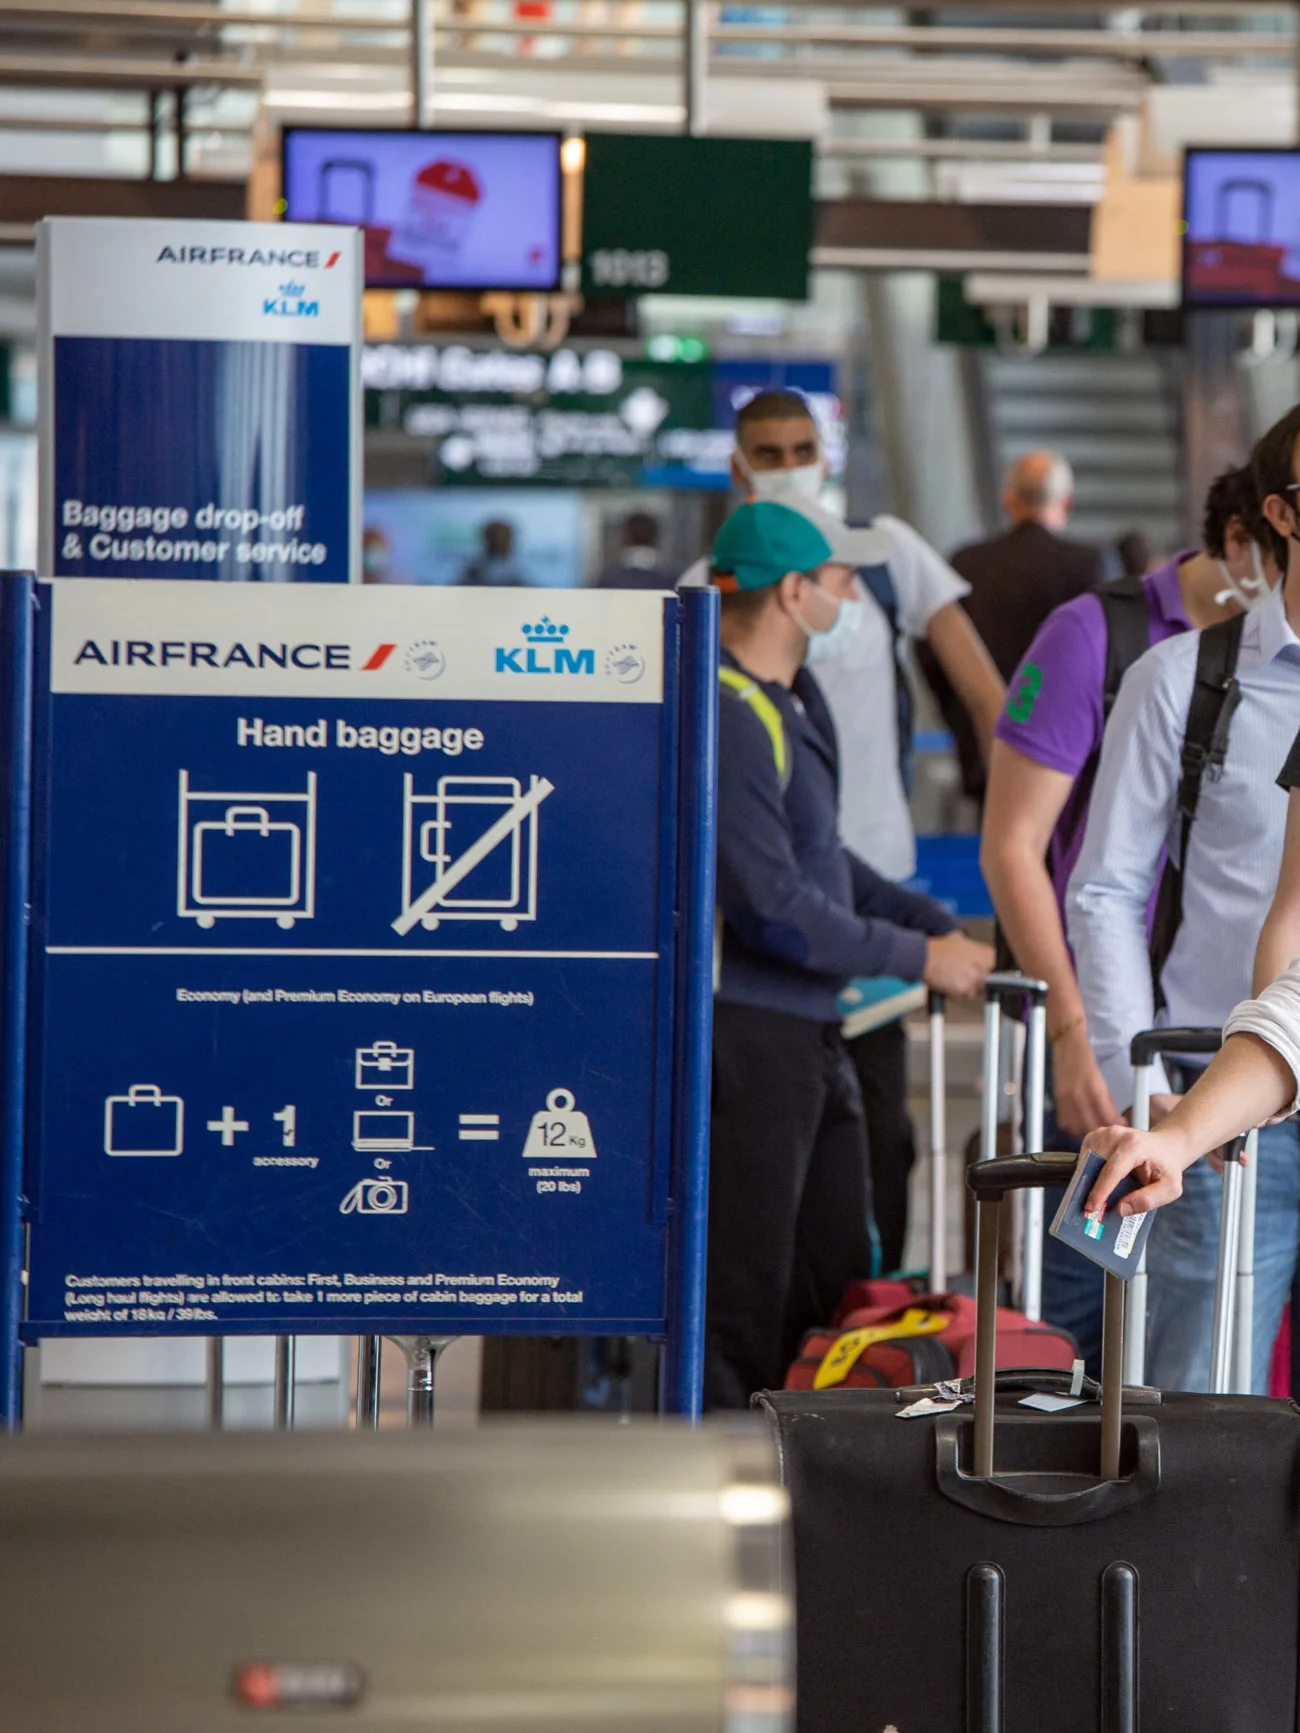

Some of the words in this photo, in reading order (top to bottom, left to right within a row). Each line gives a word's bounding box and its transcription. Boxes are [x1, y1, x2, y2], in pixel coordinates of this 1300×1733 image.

[156, 245, 320, 268] AIRFRANCE
[263, 299, 319, 317] KLM
[62, 500, 189, 533] Baggage
[194, 503, 305, 534] drop-off
[62, 533, 83, 560] &
[90, 534, 231, 562] Customer
[235, 539, 327, 565] service
[73, 639, 352, 671] AIRFRANCE
[495, 647, 595, 675] KLM
[238, 717, 328, 748] Hand
[336, 719, 485, 756] baggage
[176, 988, 241, 1005] Economy
[243, 988, 274, 1005] (and
[274, 989, 336, 1003] Premium
[337, 989, 401, 1006] Economy
[402, 992, 422, 1004] on
[423, 990, 487, 1006] European
[488, 991, 534, 1007] flights)
[375, 1094, 394, 1107] Or
[537, 1121, 567, 1147] 12
[568, 1135, 587, 1149] Kg
[252, 1156, 319, 1169] accessory
[373, 1157, 393, 1170] Or
[528, 1165, 591, 1178] maximum
[536, 1180, 557, 1195] (20
[558, 1180, 582, 1195] lbs)
[65, 1274, 142, 1288] Customers
[142, 1274, 206, 1289] travelling
[206, 1274, 221, 1286] in
[221, 1274, 256, 1286] front
[256, 1274, 306, 1286] cabins:
[307, 1273, 343, 1288] First,
[343, 1273, 406, 1286] Business
[406, 1274, 434, 1286] and
[434, 1273, 496, 1286] Premium
[496, 1273, 561, 1289] Economy
[65, 1291, 106, 1307] (Long
[106, 1291, 138, 1304] haul
[138, 1291, 186, 1307] flights)
[186, 1294, 210, 1304] are
[210, 1290, 265, 1303] allowed
[265, 1290, 282, 1303] to
[283, 1290, 315, 1303] take
[317, 1290, 324, 1303] 1
[326, 1292, 363, 1303] more
[363, 1290, 402, 1305] piece
[402, 1290, 419, 1303] of
[419, 1290, 458, 1303] cabin
[459, 1290, 518, 1306] baggage
[518, 1290, 541, 1303] for
[541, 1293, 551, 1303] a
[552, 1290, 584, 1303] total
[64, 1308, 112, 1321] weight
[112, 1308, 130, 1320] of
